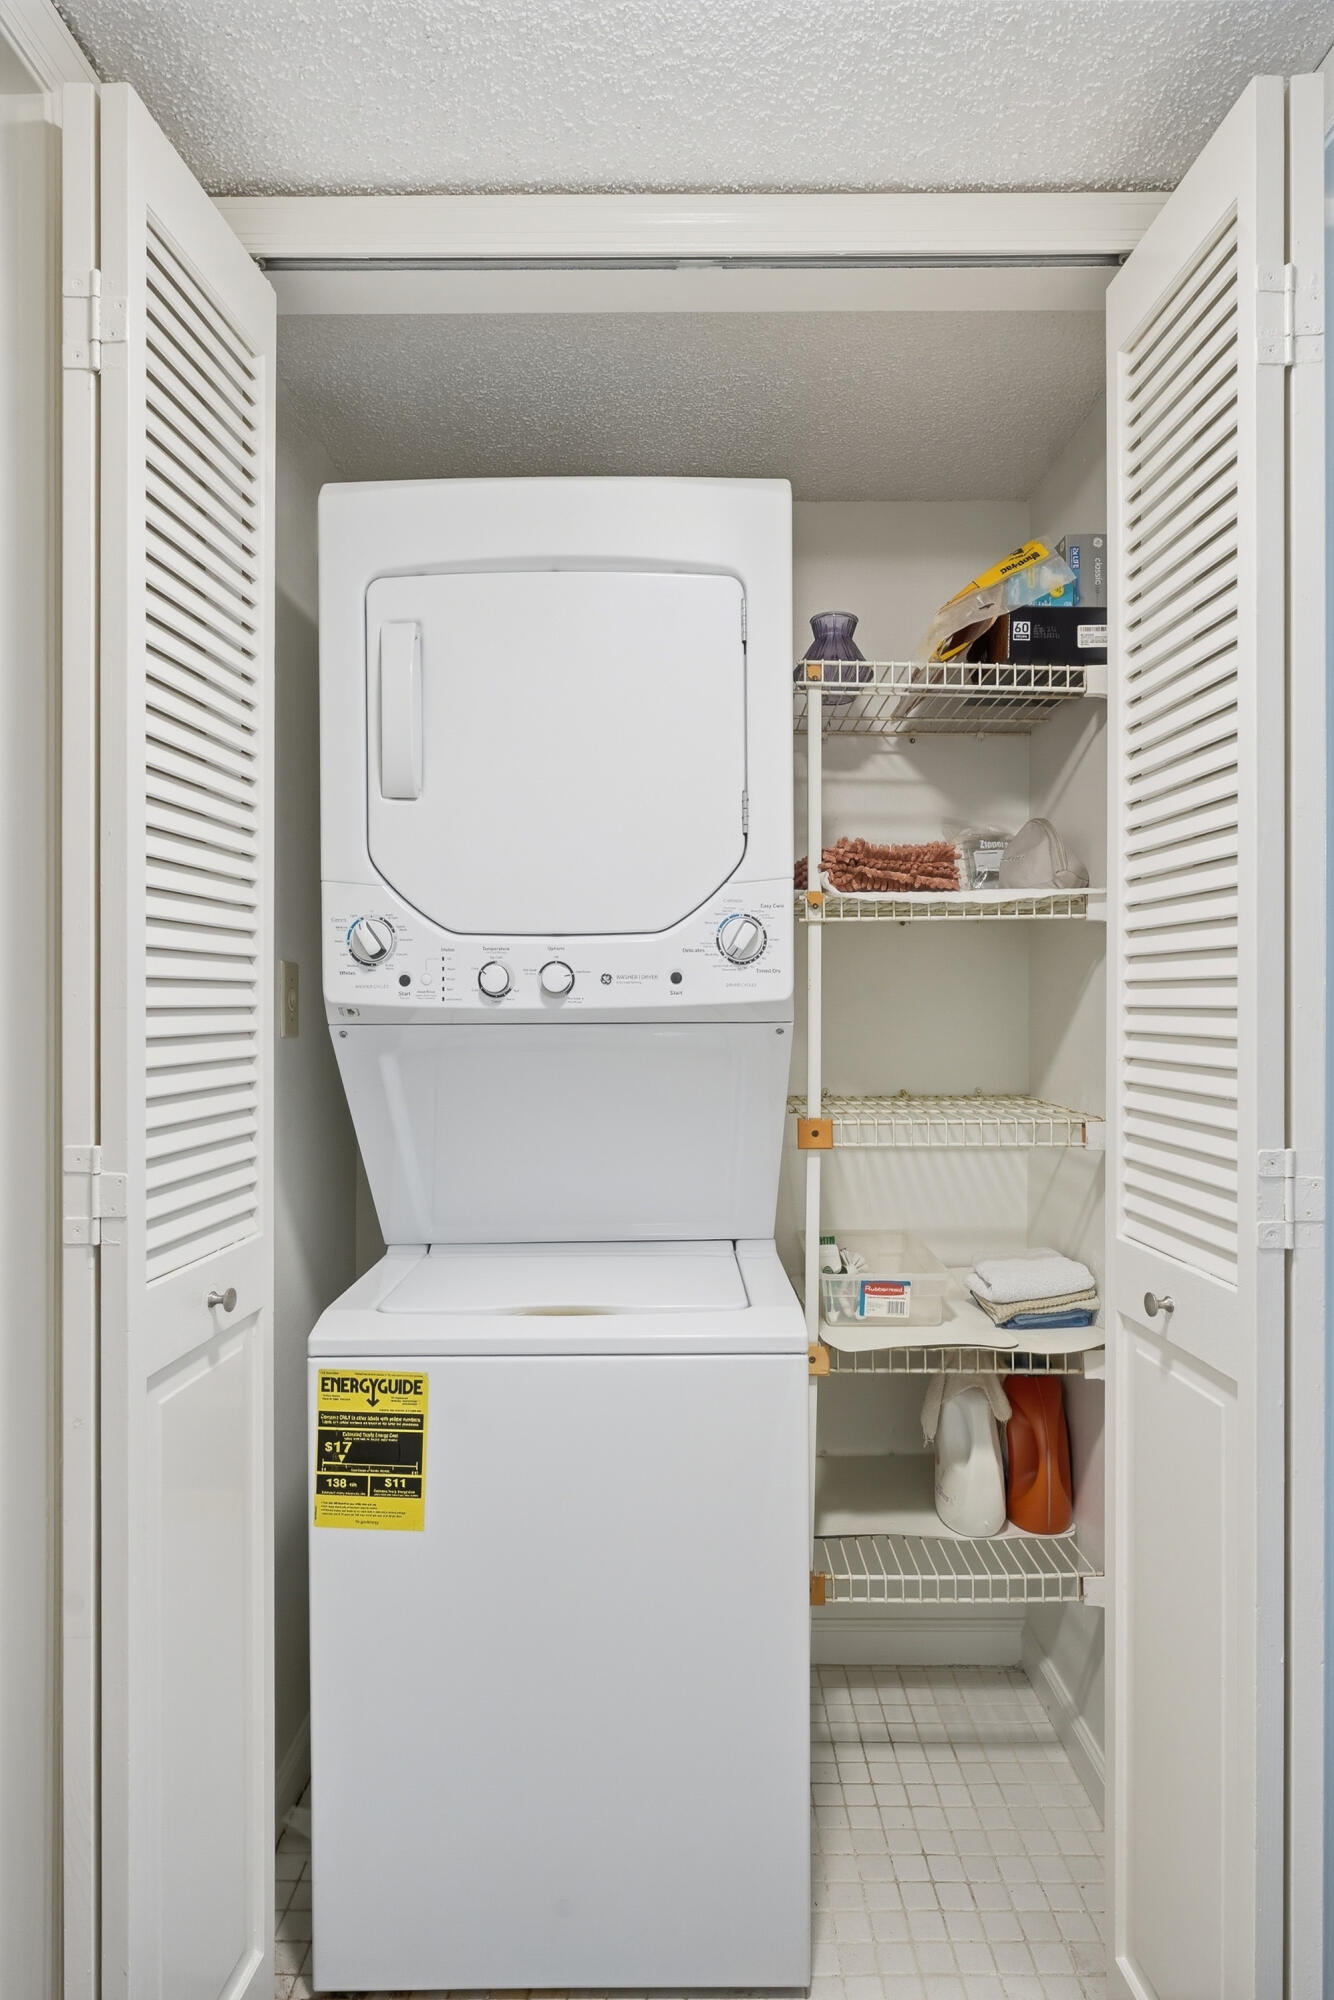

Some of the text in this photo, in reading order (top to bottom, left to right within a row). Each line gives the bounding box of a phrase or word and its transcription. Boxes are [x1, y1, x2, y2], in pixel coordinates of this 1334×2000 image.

[1094, 557, 1103, 586] classic
[1014, 622, 1029, 633] 60
[321, 1376, 423, 1396] ENERGYGUIDE
[324, 1441, 352, 1453] $17
[326, 1478, 347, 1488] 138
[384, 1478, 406, 1488] $11
